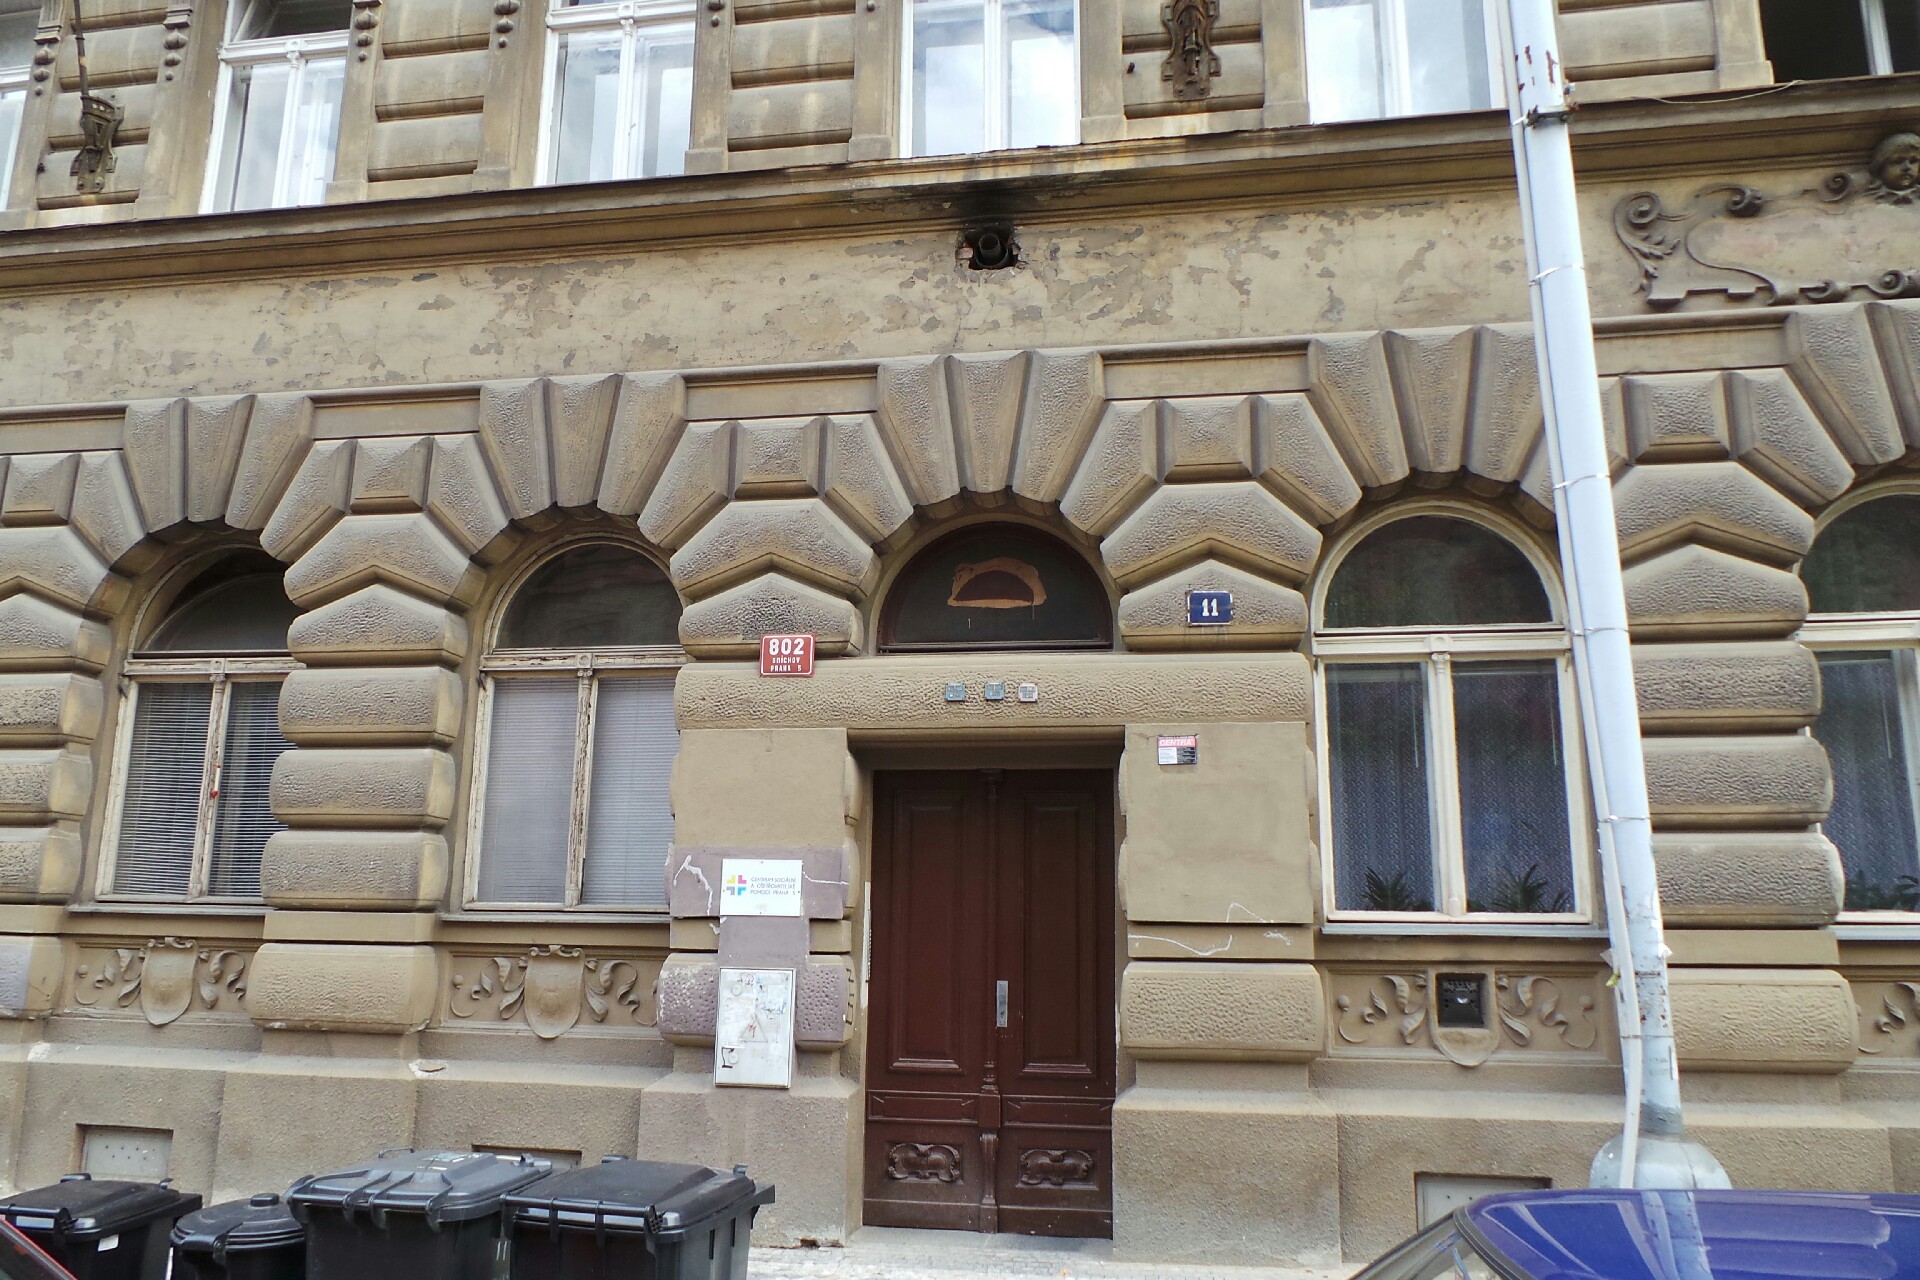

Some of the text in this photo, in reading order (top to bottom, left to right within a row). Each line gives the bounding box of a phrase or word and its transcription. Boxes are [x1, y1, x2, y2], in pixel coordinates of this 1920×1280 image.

[1202, 598, 1219, 617] 11
[769, 638, 805, 656] 802
[772, 656, 801, 664] SMÍCHOV
